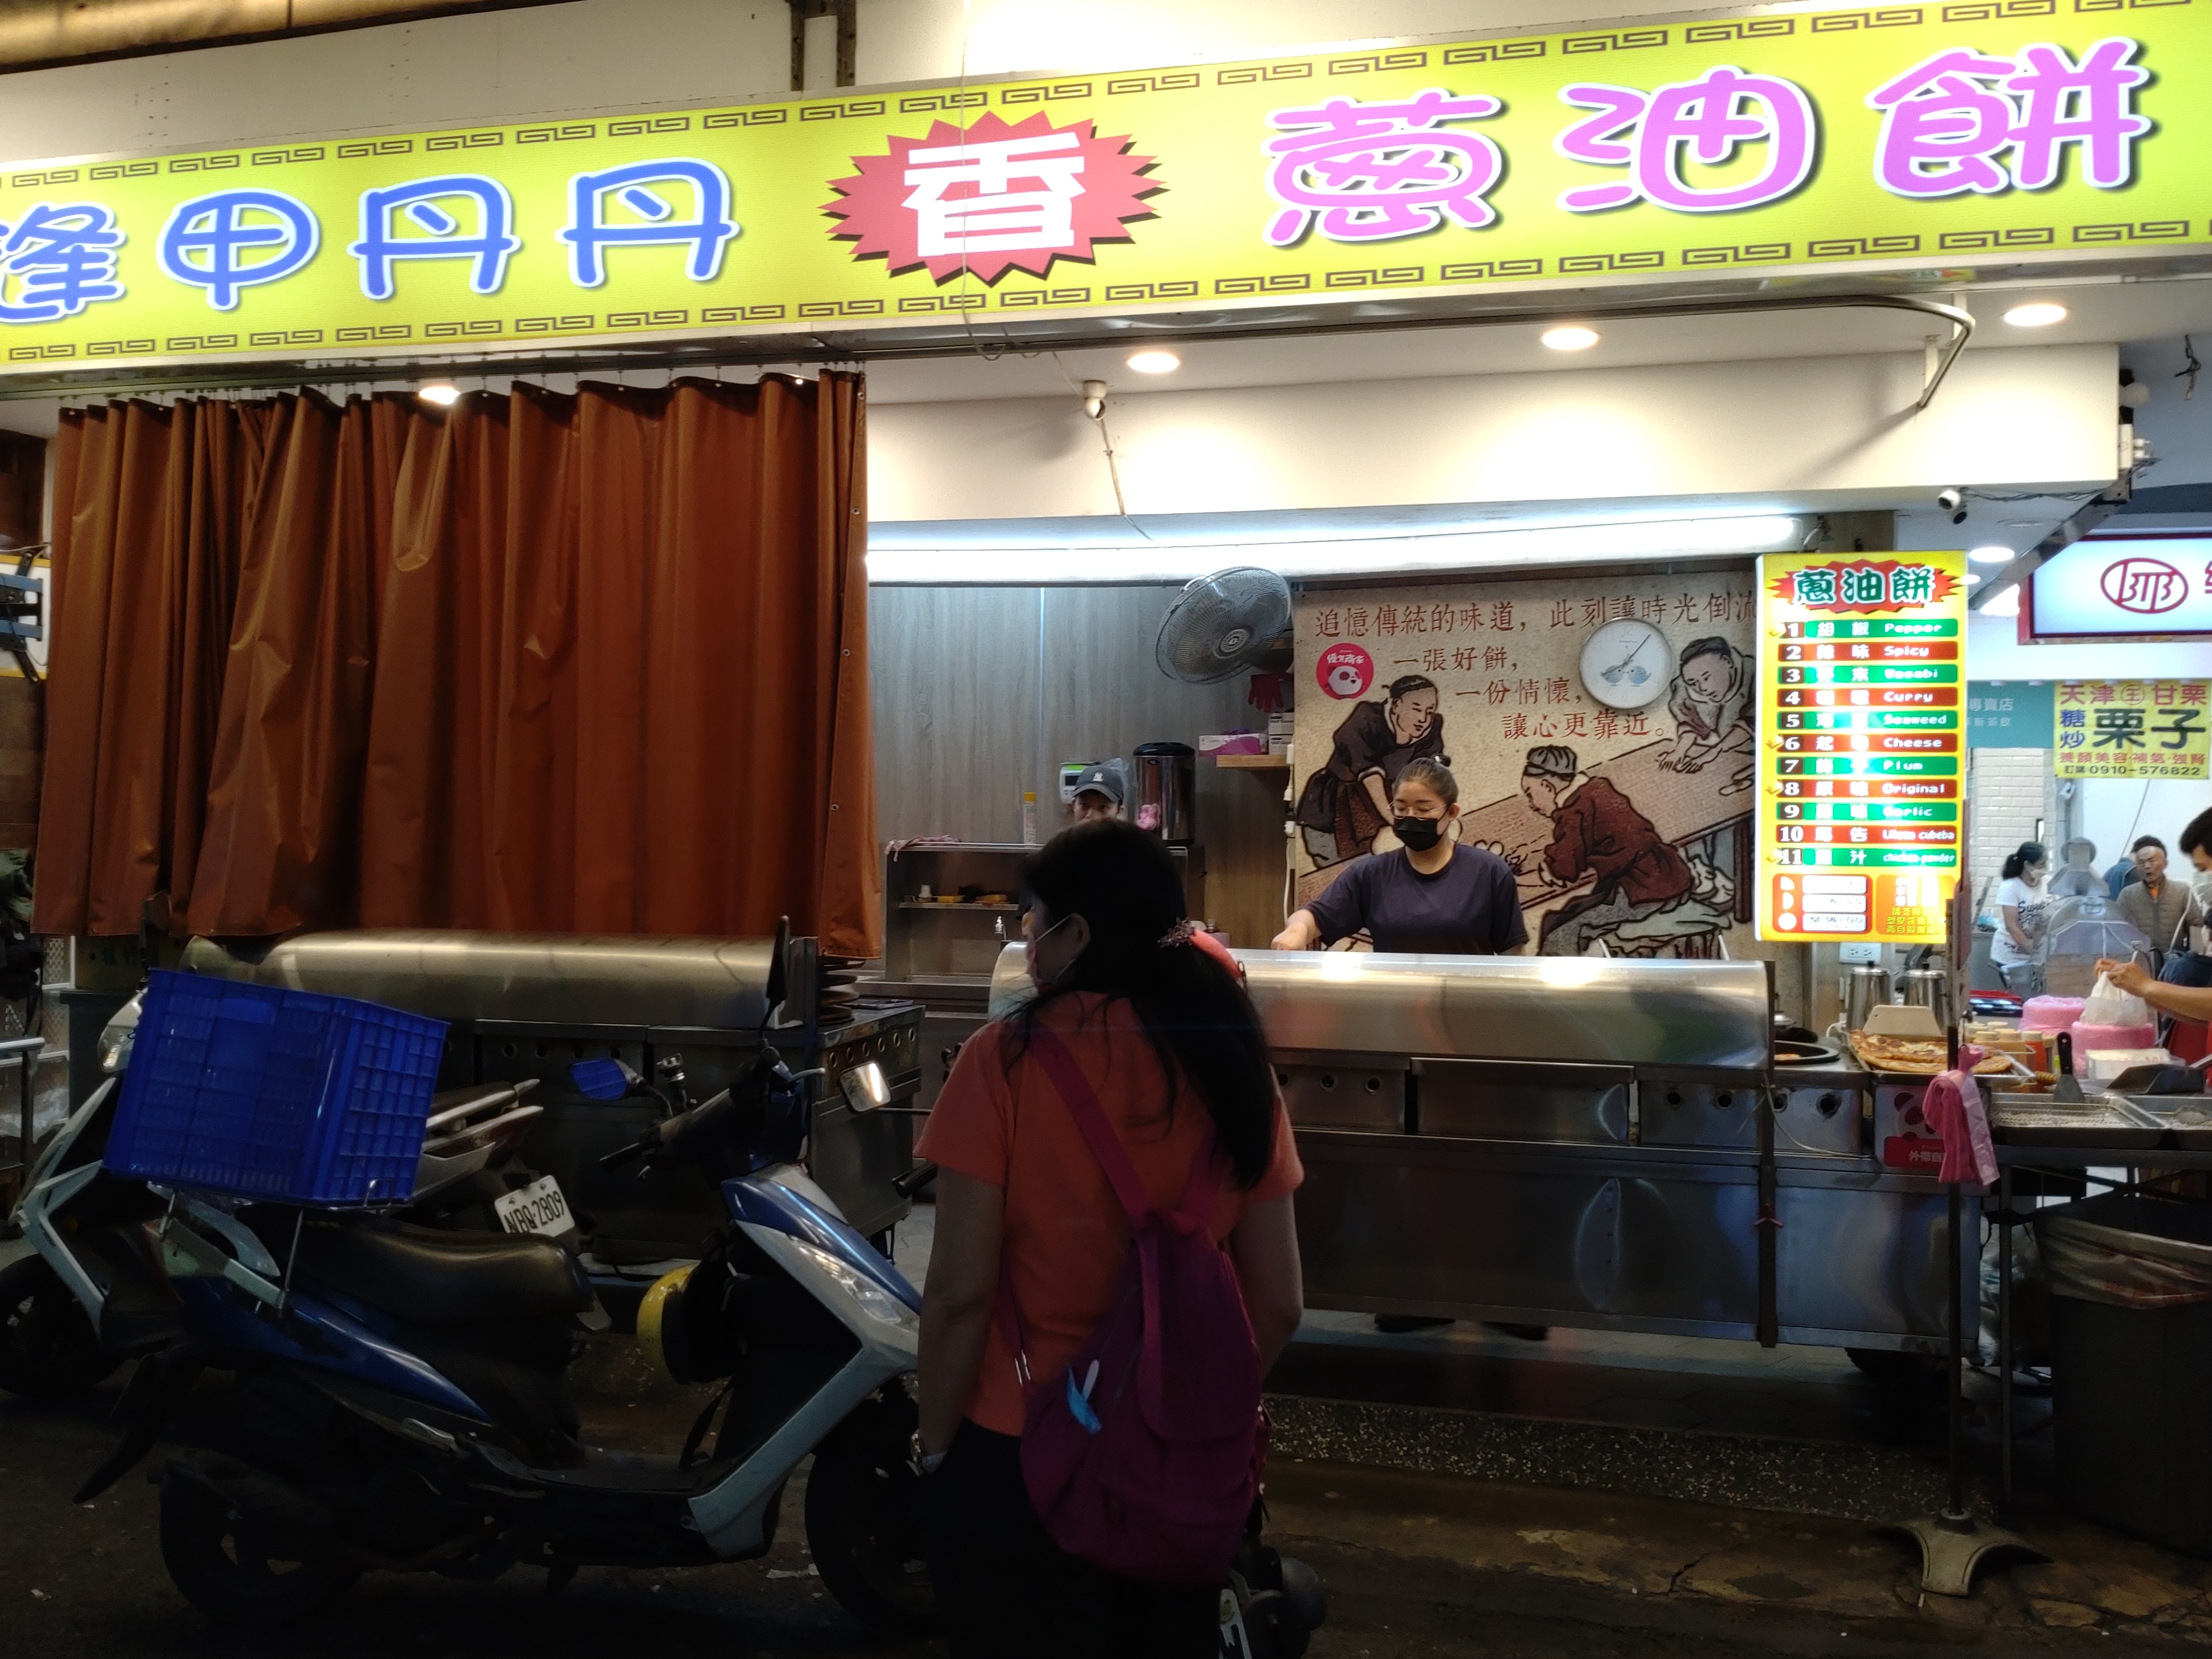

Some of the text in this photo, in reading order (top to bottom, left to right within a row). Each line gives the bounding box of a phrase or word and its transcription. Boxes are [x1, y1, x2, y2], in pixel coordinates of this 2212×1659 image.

[901, 132, 1086, 257] 香
[1261, 35, 2151, 247] 蔥油餅
[1793, 567, 1935, 604] 蔥油餅
[1788, 623, 1798, 636] 1
[1885, 623, 1942, 634] Pepper
[1786, 646, 1801, 659] 2
[1885, 646, 1929, 657] Spicy
[1786, 669, 1801, 682] 3
[1786, 692, 1933, 704] 4 Curry
[1786, 715, 1800, 727] 5
[1884, 714, 1947, 725] Seaweed
[2059, 708, 2085, 748] 糖炒
[2092, 708, 2206, 749] 栗子
[1786, 735, 1942, 751] 6 起 Cheese
[1786, 760, 1799, 773] 7
[1883, 760, 1923, 771] Plum
[1785, 782, 1800, 795] 8
[1882, 782, 1944, 794] Original
[1785, 806, 1799, 818] 9
[1780, 827, 1803, 842] 10
[1780, 849, 1802, 865] 11
[1815, 849, 1867, 865] 汁
